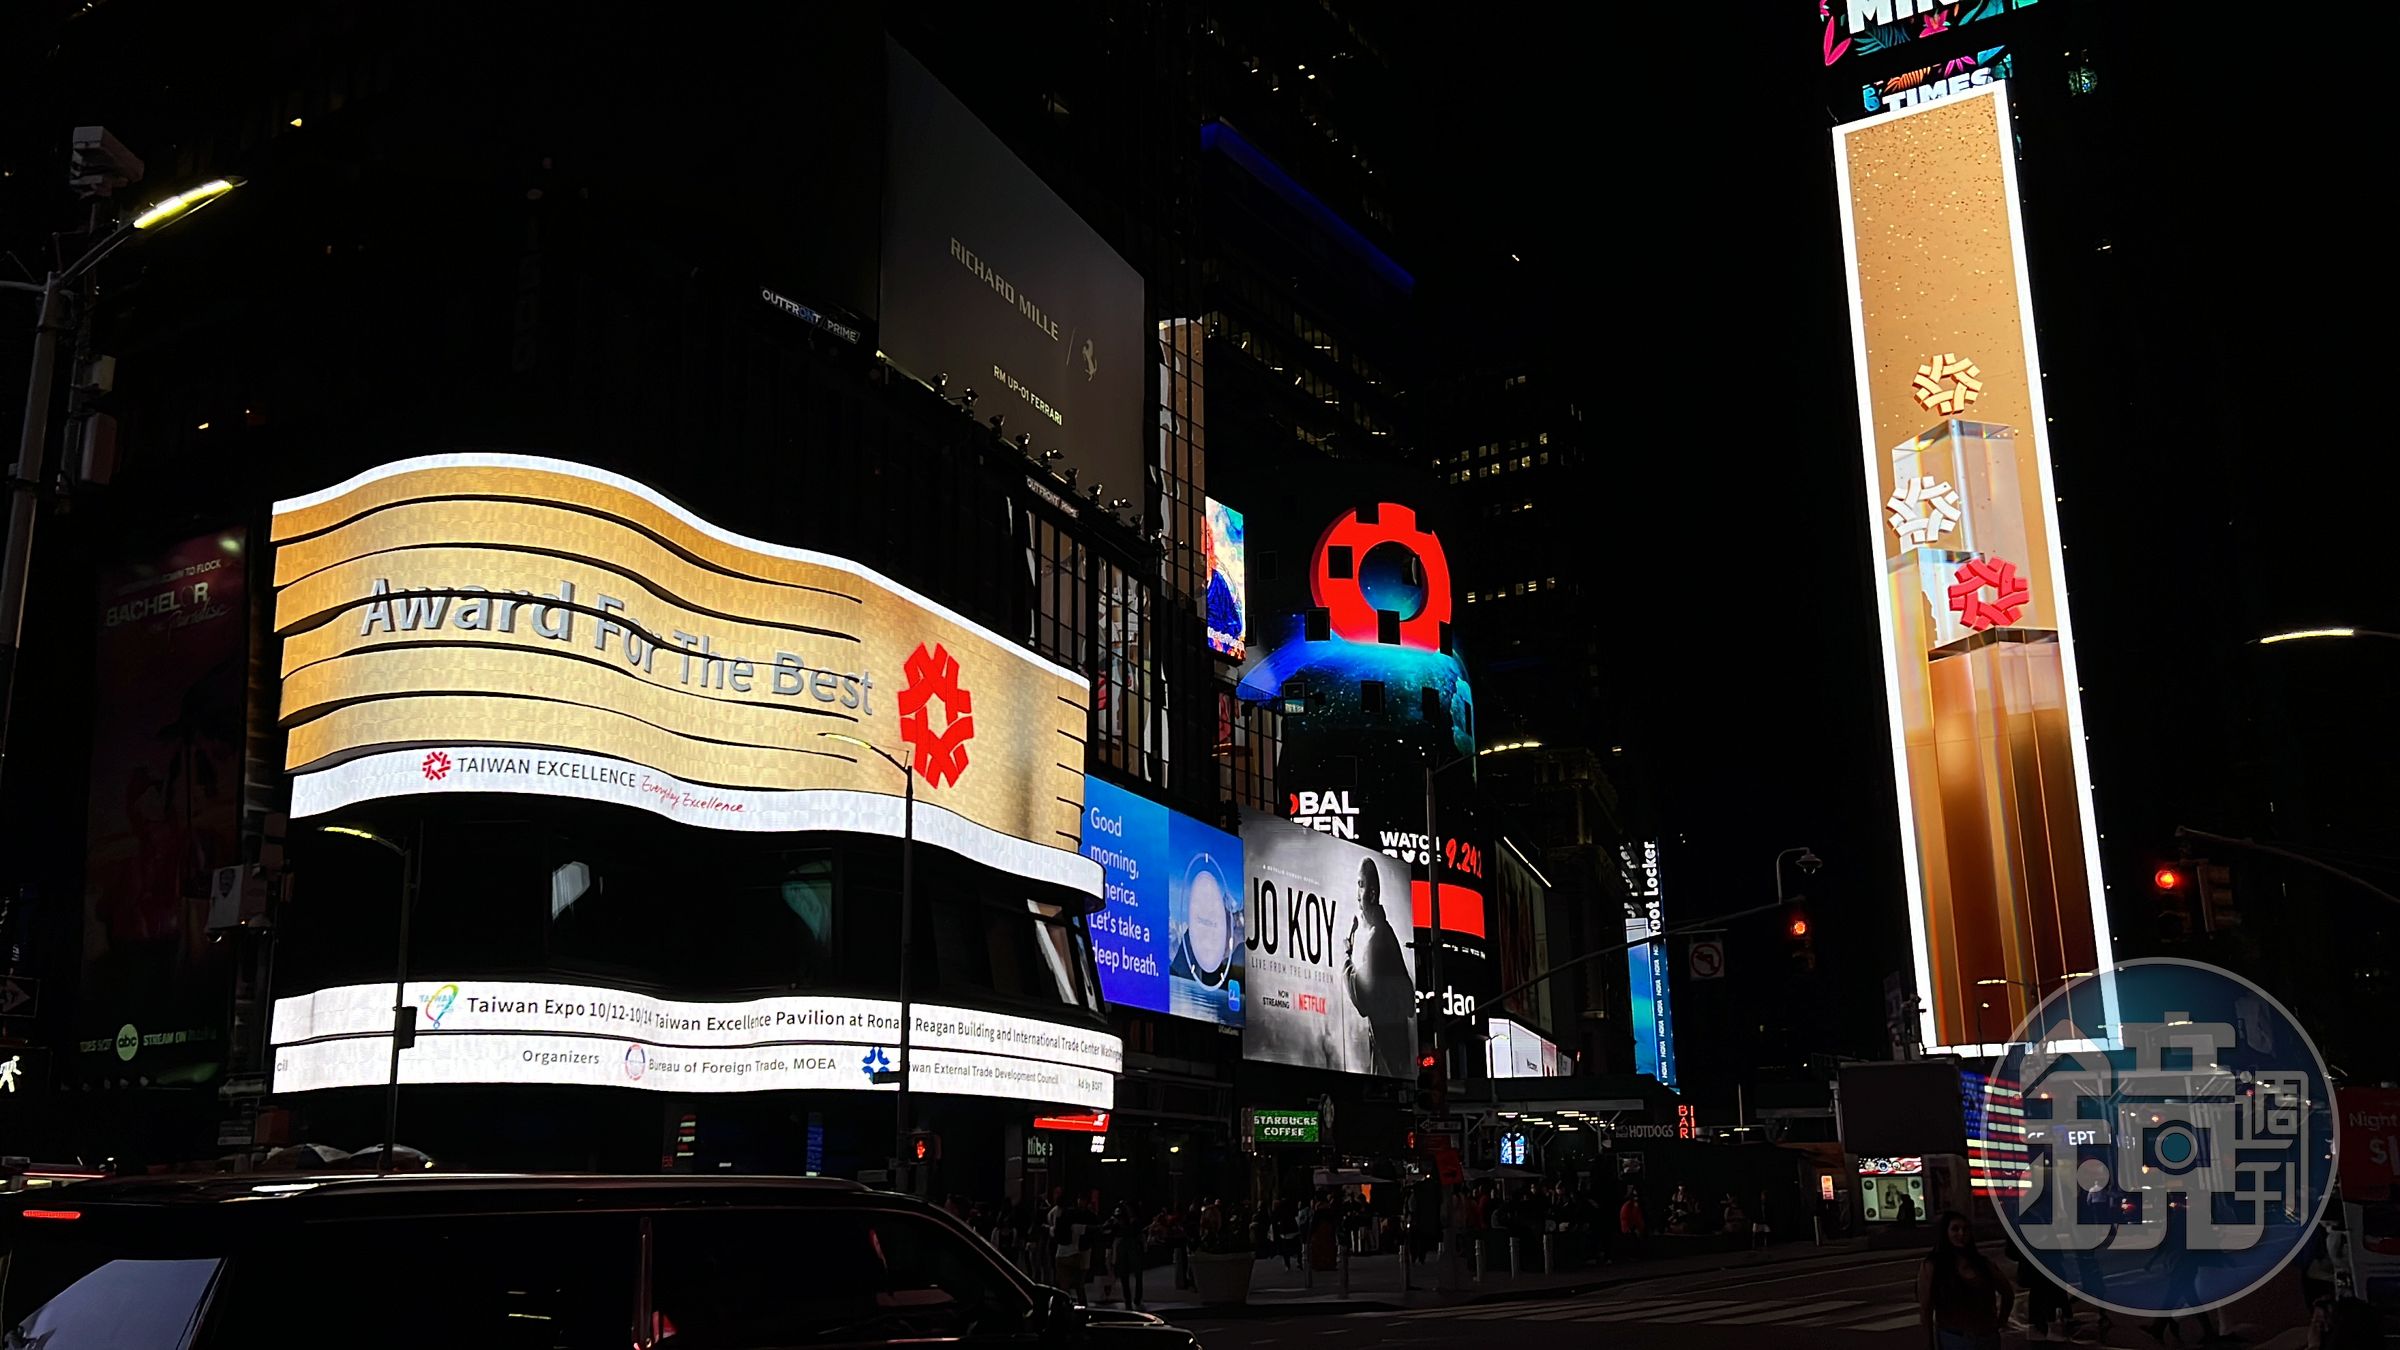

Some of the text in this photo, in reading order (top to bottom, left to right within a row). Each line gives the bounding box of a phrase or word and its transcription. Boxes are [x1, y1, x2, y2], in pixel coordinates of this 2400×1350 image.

[1882, 66, 1993, 112] TIMES
[951, 237, 1059, 341] RICHARD MILLE
[762, 289, 857, 341] OUTFRONT PRIME
[993, 364, 1062, 426] RM UP-01 FERRARI
[360, 578, 873, 715] Award For The Best
[458, 757, 636, 788] TAIWAN EXCELLENCE
[641, 775, 746, 813] Everyday Excellence
[1090, 807, 1122, 837] Good
[1380, 831, 1441, 852] WATC
[1090, 845, 1139, 880] morning,
[1642, 841, 1659, 896] Locker
[1090, 910, 1150, 942] Let's take a
[1246, 877, 1337, 967] JO KOY
[1122, 946, 1159, 977] breath.
[1262, 997, 1289, 1009] STREAMING
[1299, 993, 1327, 1015] NETFLIX
[118, 1033, 137, 1049] abc
[467, 997, 539, 1015] Taiwan
[545, 998, 585, 1018] Expo
[590, 1001, 653, 1026] 10/12-10/14
[655, 1013, 701, 1031] Taiwan
[707, 1013, 771, 1033] Excellence
[776, 1010, 845, 1028] Pavilion
[849, 1014, 863, 1028] at
[867, 1014, 911, 1032] Rona
[915, 1017, 955, 1037] Reagan
[958, 1021, 995, 1042] Building
[997, 1028, 1012, 1042] and
[1013, 1029, 1060, 1048] International
[1061, 1037, 1079, 1052] Trade
[1080, 1041, 1100, 1056] Center
[522, 1049, 600, 1065] Organizers
[648, 1058, 837, 1076] Bureau of Foreign Trade, MOEA
[934, 1063, 970, 1076] External
[972, 1065, 993, 1078] Trade
[995, 1067, 1036, 1082] Development
[1254, 1115, 1318, 1126] STARBUCKS
[1264, 1127, 1304, 1136] COFFEE
[1629, 1124, 1674, 1138] HOTDOGS
[2348, 1110, 2398, 1131] Night
